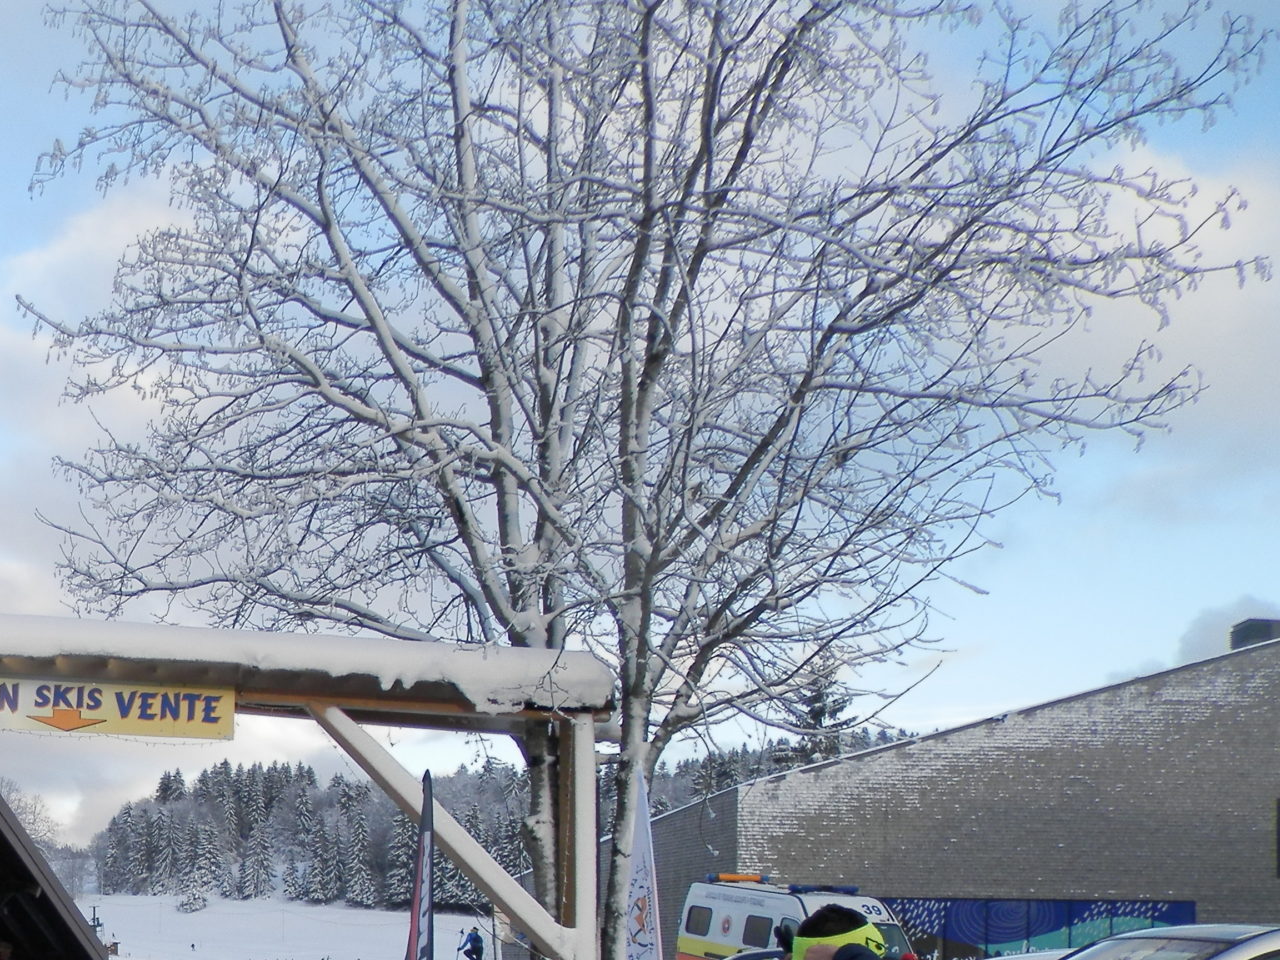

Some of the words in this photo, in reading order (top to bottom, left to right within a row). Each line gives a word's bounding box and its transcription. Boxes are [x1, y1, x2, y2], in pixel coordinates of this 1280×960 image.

[34, 684, 103, 711] SKIS
[114, 690, 224, 724] VENTE
[862, 904, 882, 916] 39
